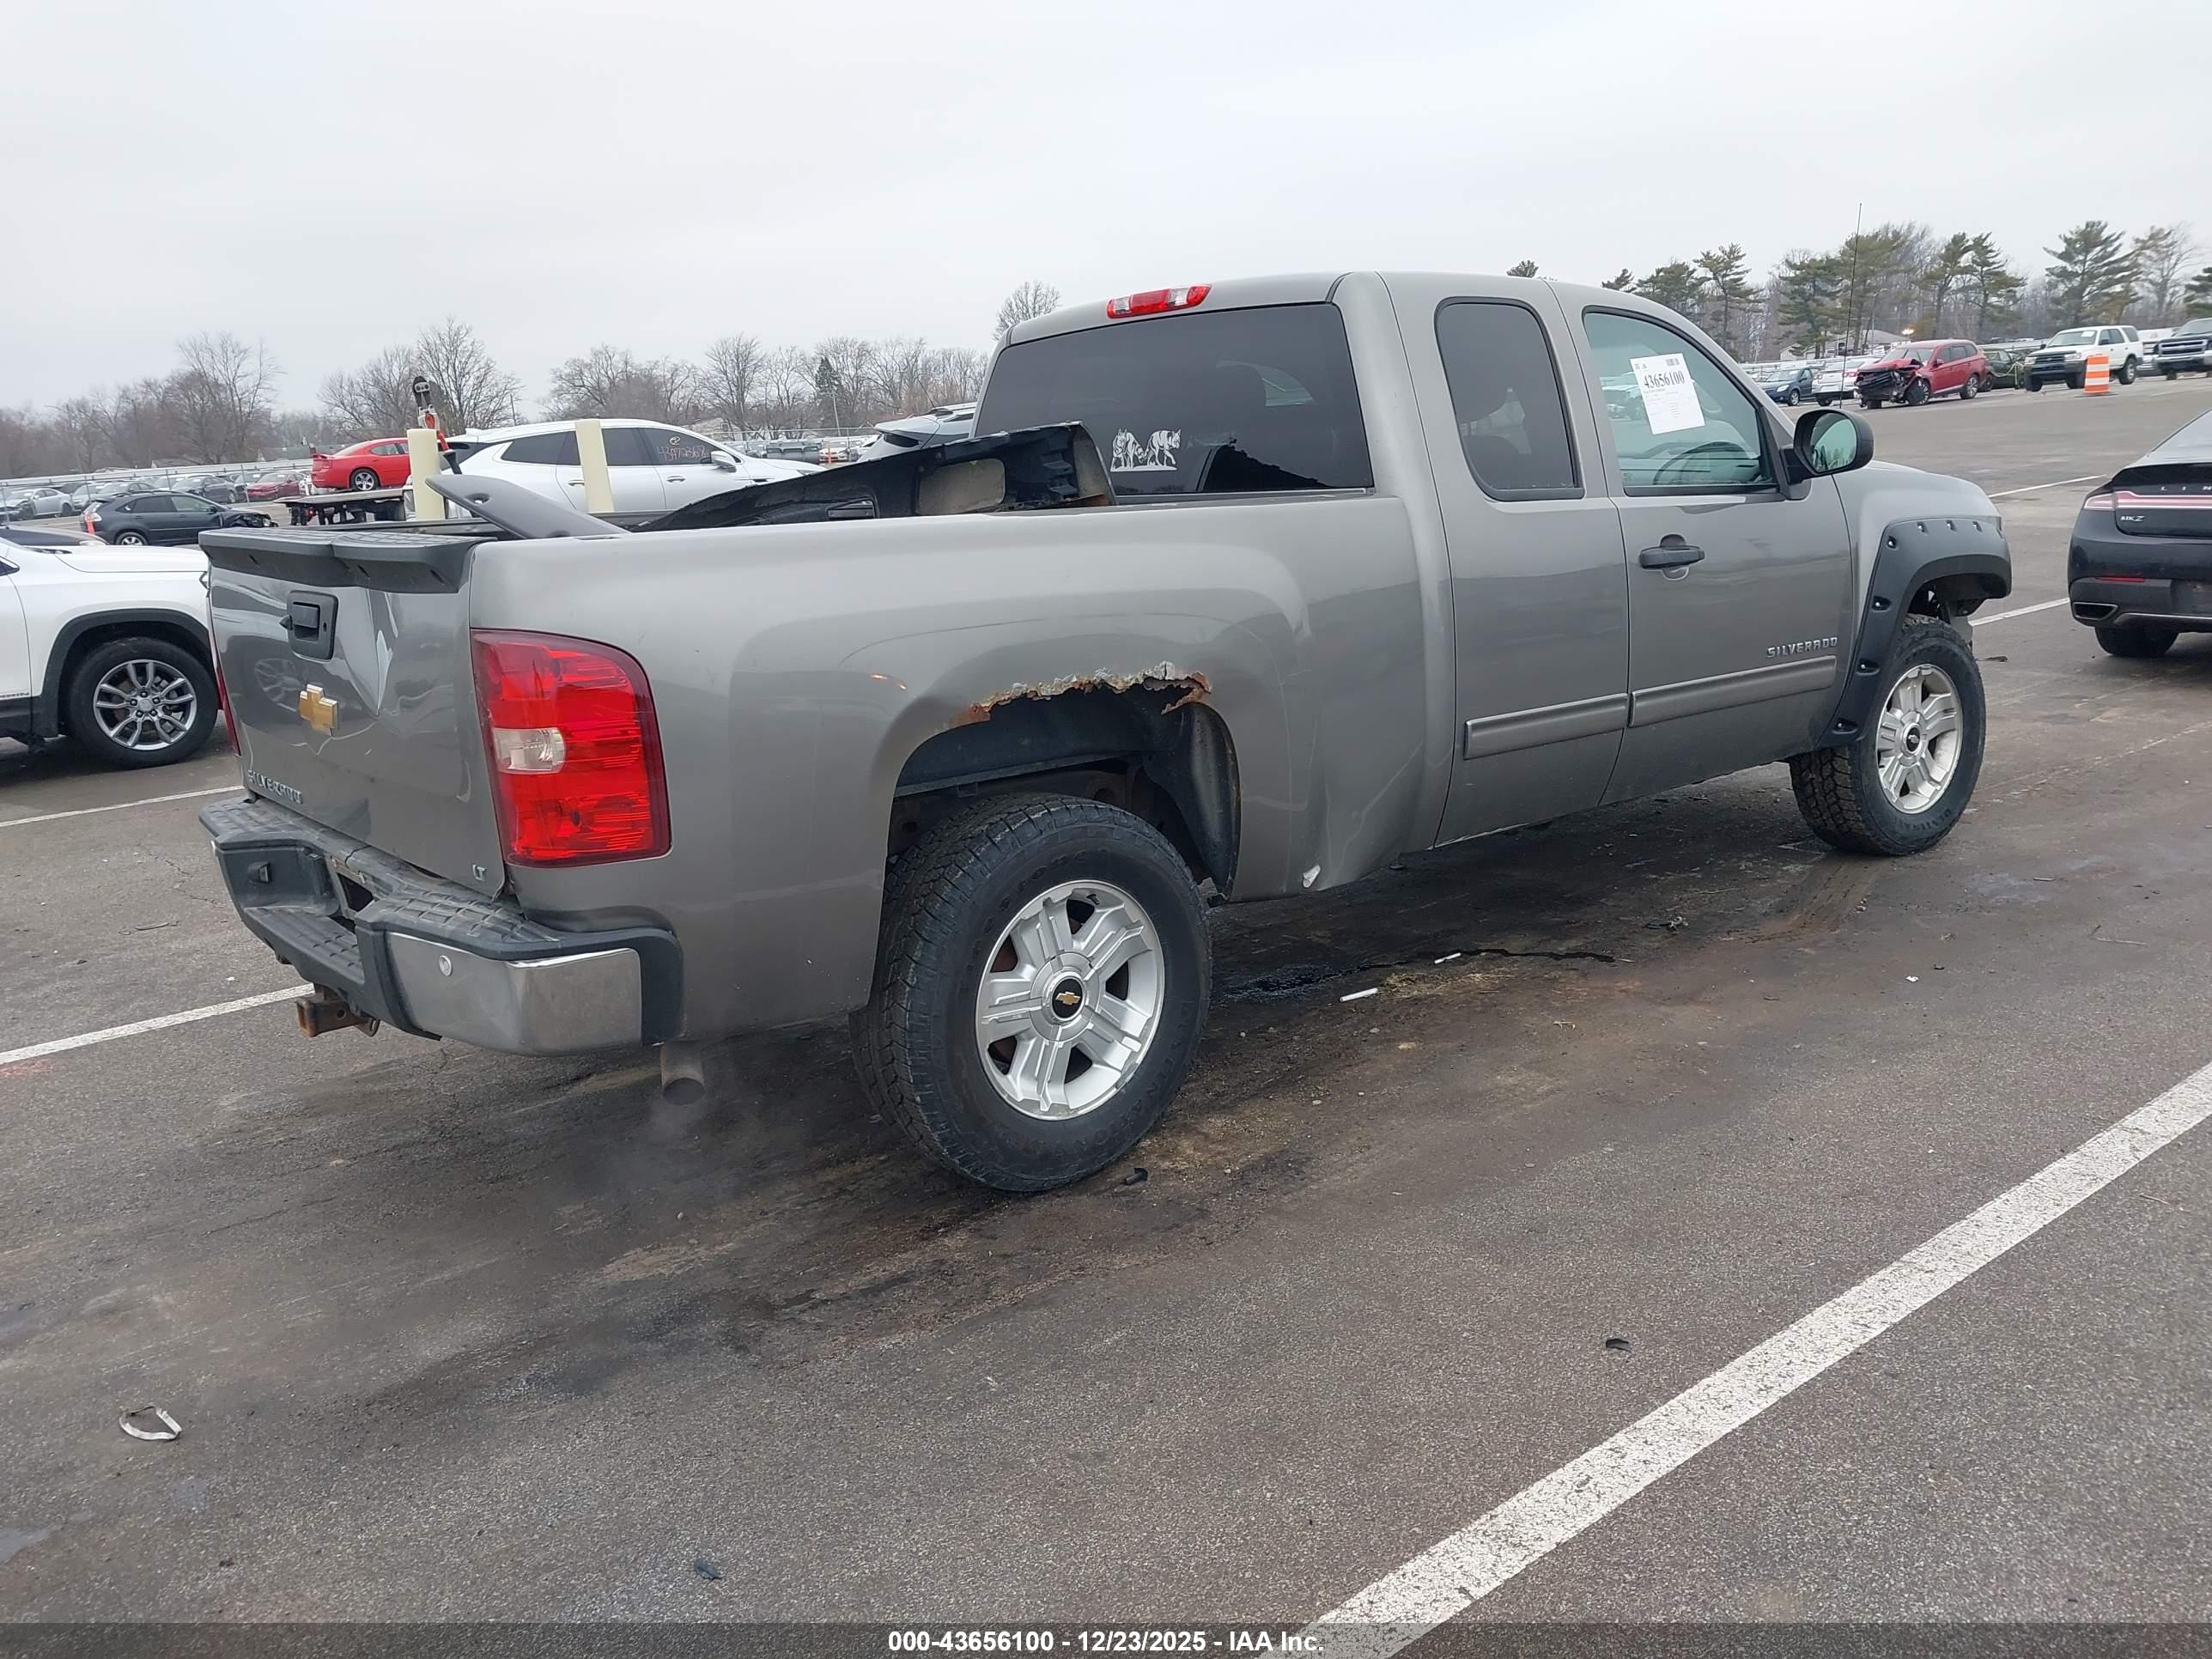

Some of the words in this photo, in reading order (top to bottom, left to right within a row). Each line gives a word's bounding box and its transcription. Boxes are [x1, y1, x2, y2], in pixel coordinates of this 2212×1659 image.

[1644, 370, 1685, 389] 43656100
[1767, 636, 1838, 658] SILVERADO
[472, 864, 487, 881] LT
